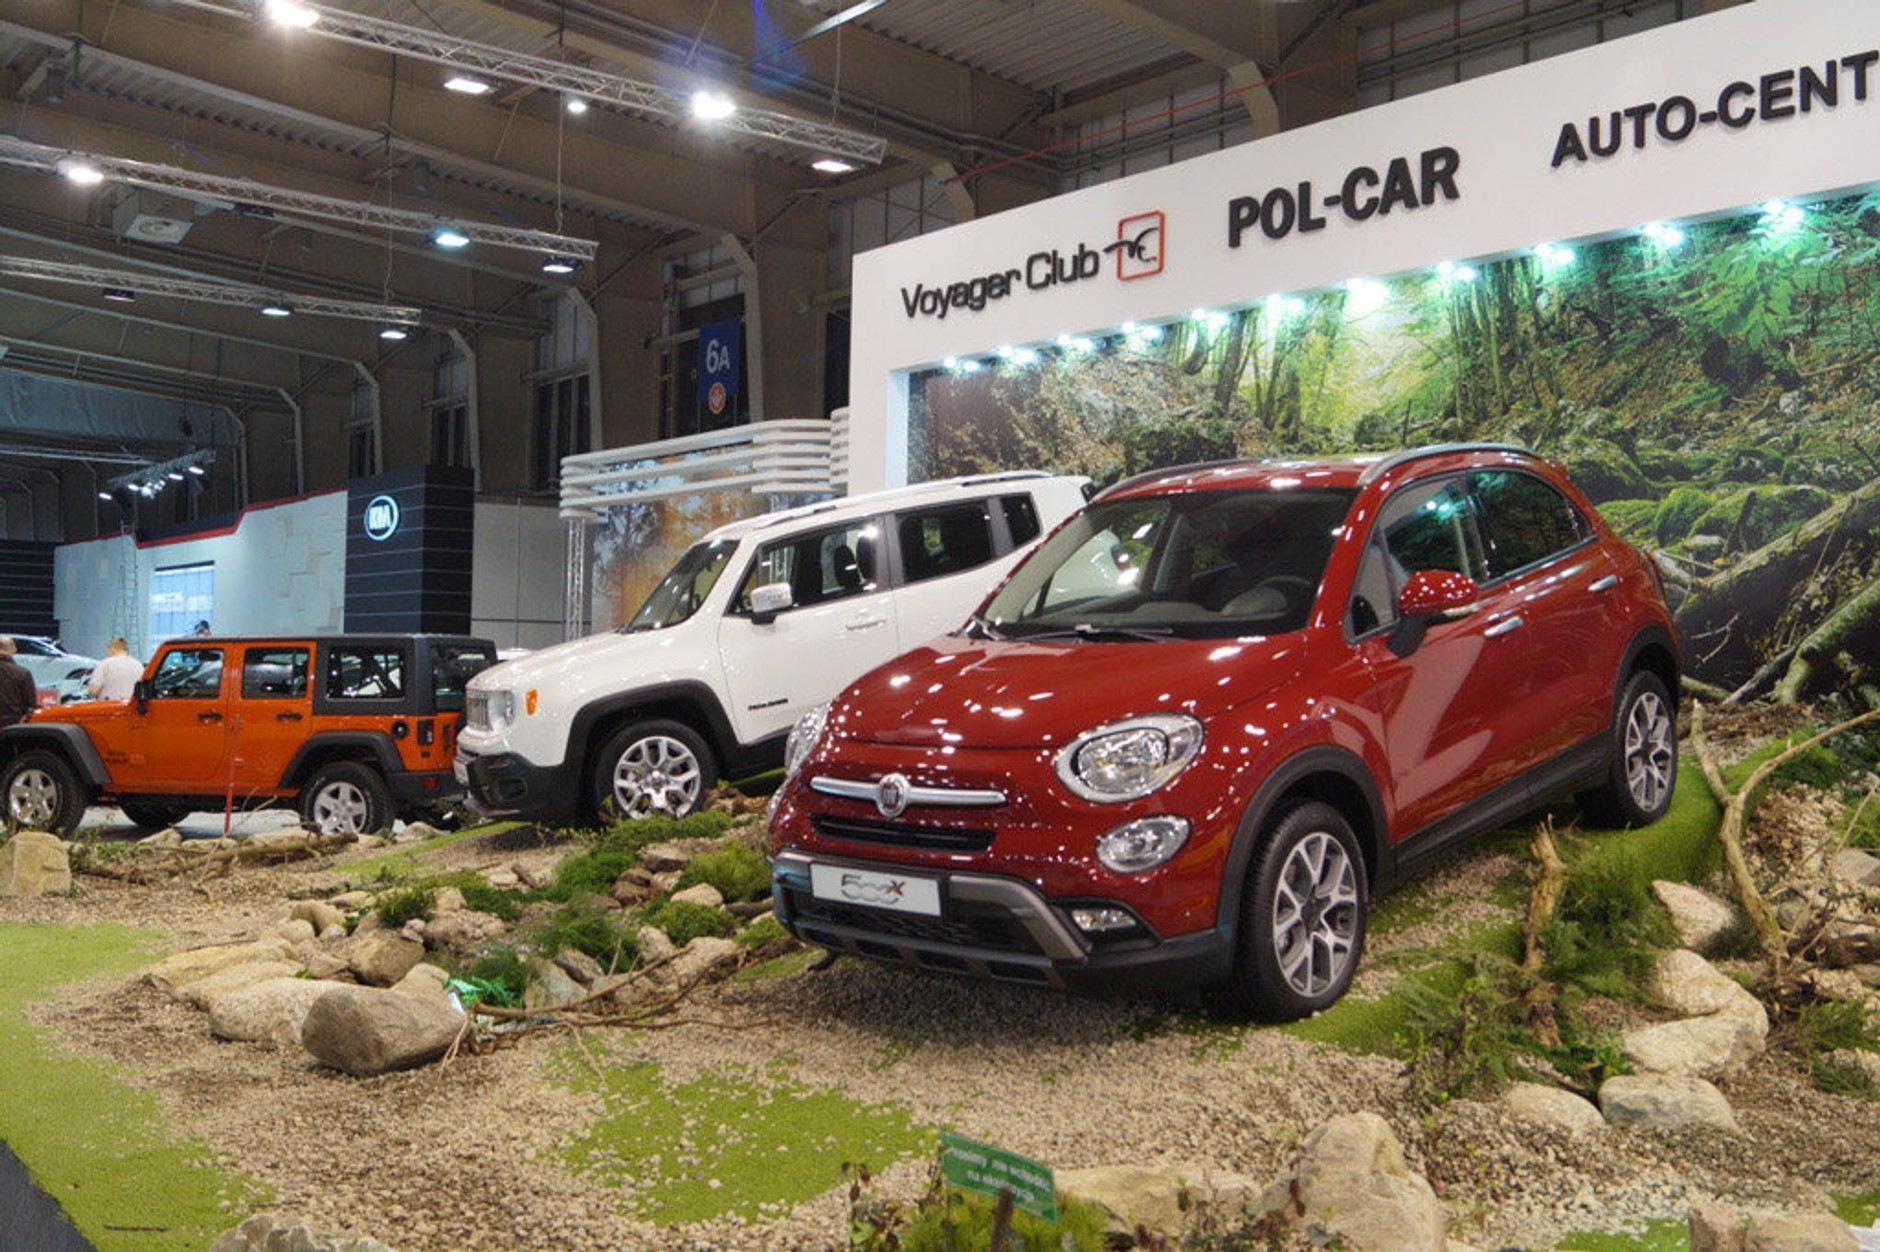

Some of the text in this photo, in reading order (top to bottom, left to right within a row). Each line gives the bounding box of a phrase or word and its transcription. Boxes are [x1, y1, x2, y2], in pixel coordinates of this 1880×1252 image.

[1551, 50, 1880, 168] AUTO-CENT
[1228, 147, 1461, 248] POL-CAR
[901, 243, 1099, 319] Voyager Club
[706, 338, 731, 374] 6A
